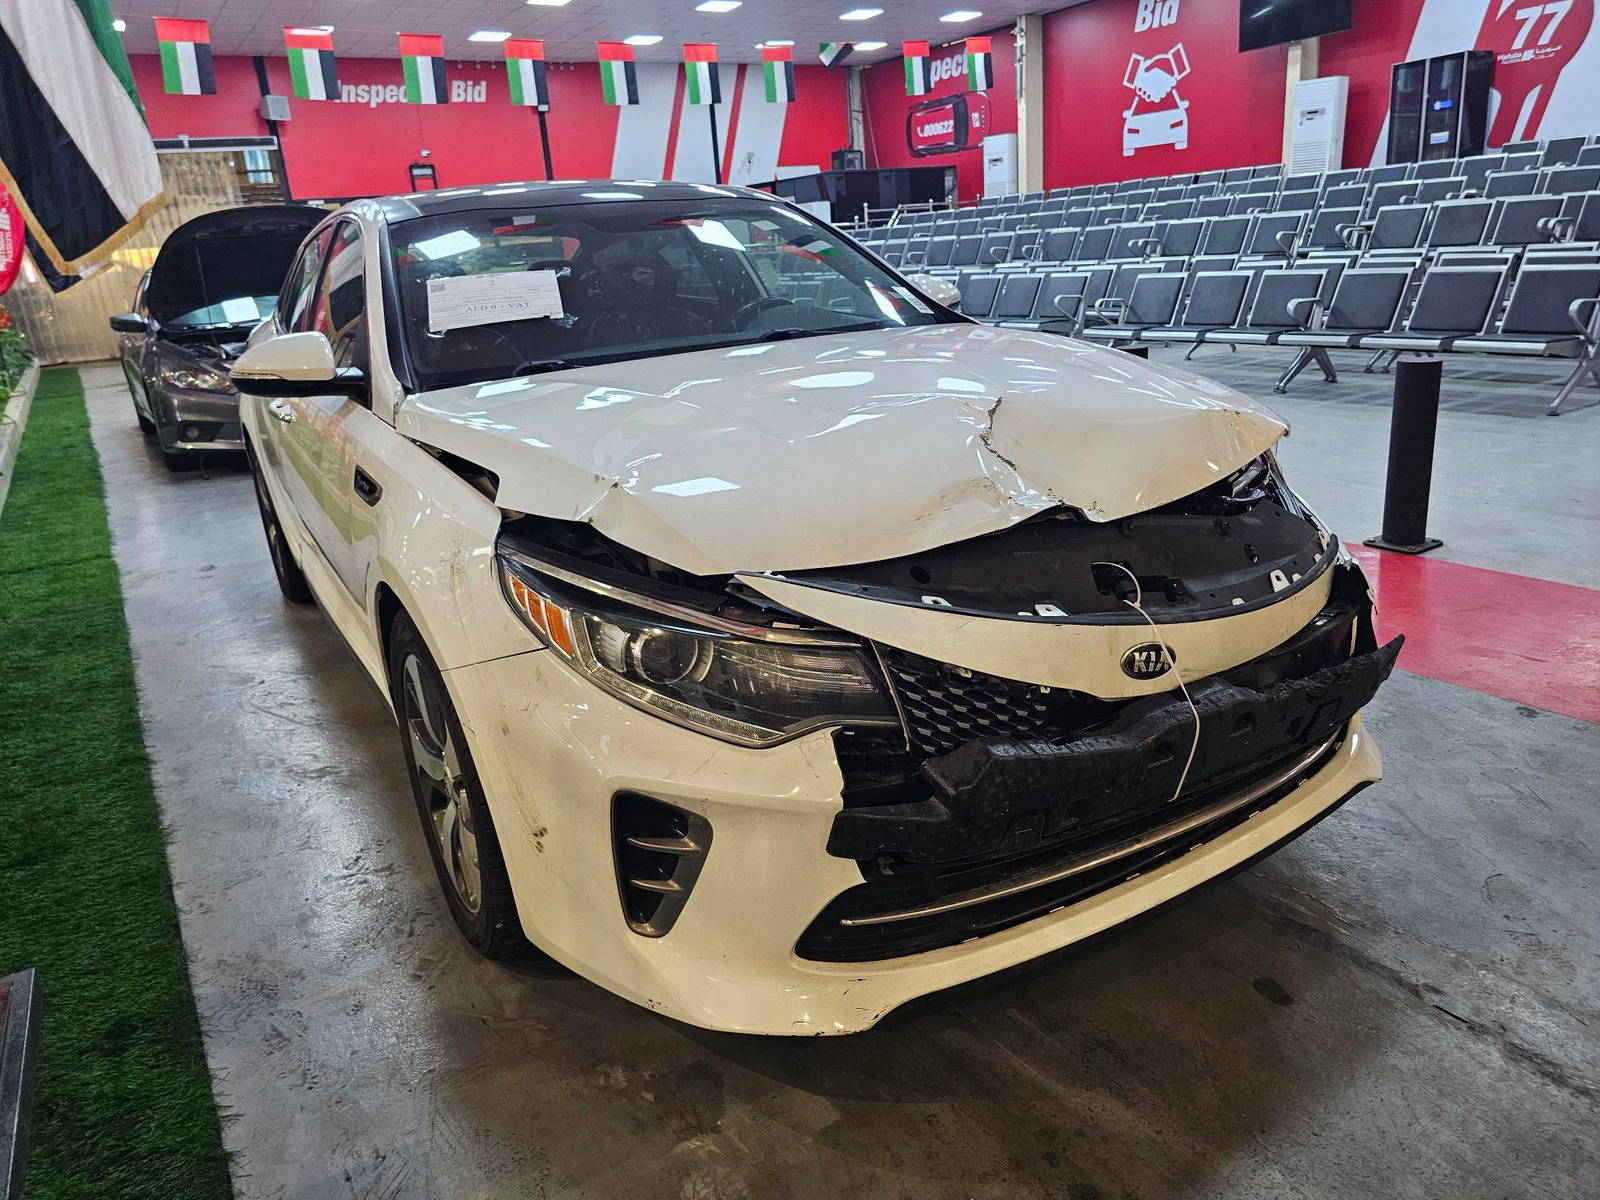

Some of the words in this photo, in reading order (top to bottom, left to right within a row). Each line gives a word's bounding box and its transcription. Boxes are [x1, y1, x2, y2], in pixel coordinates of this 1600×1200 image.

[1134, 0, 1180, 33] Bid
[1511, 0, 1574, 50] 77
[452, 80, 487, 103] Bid
[1133, 650, 1170, 672] KIA
